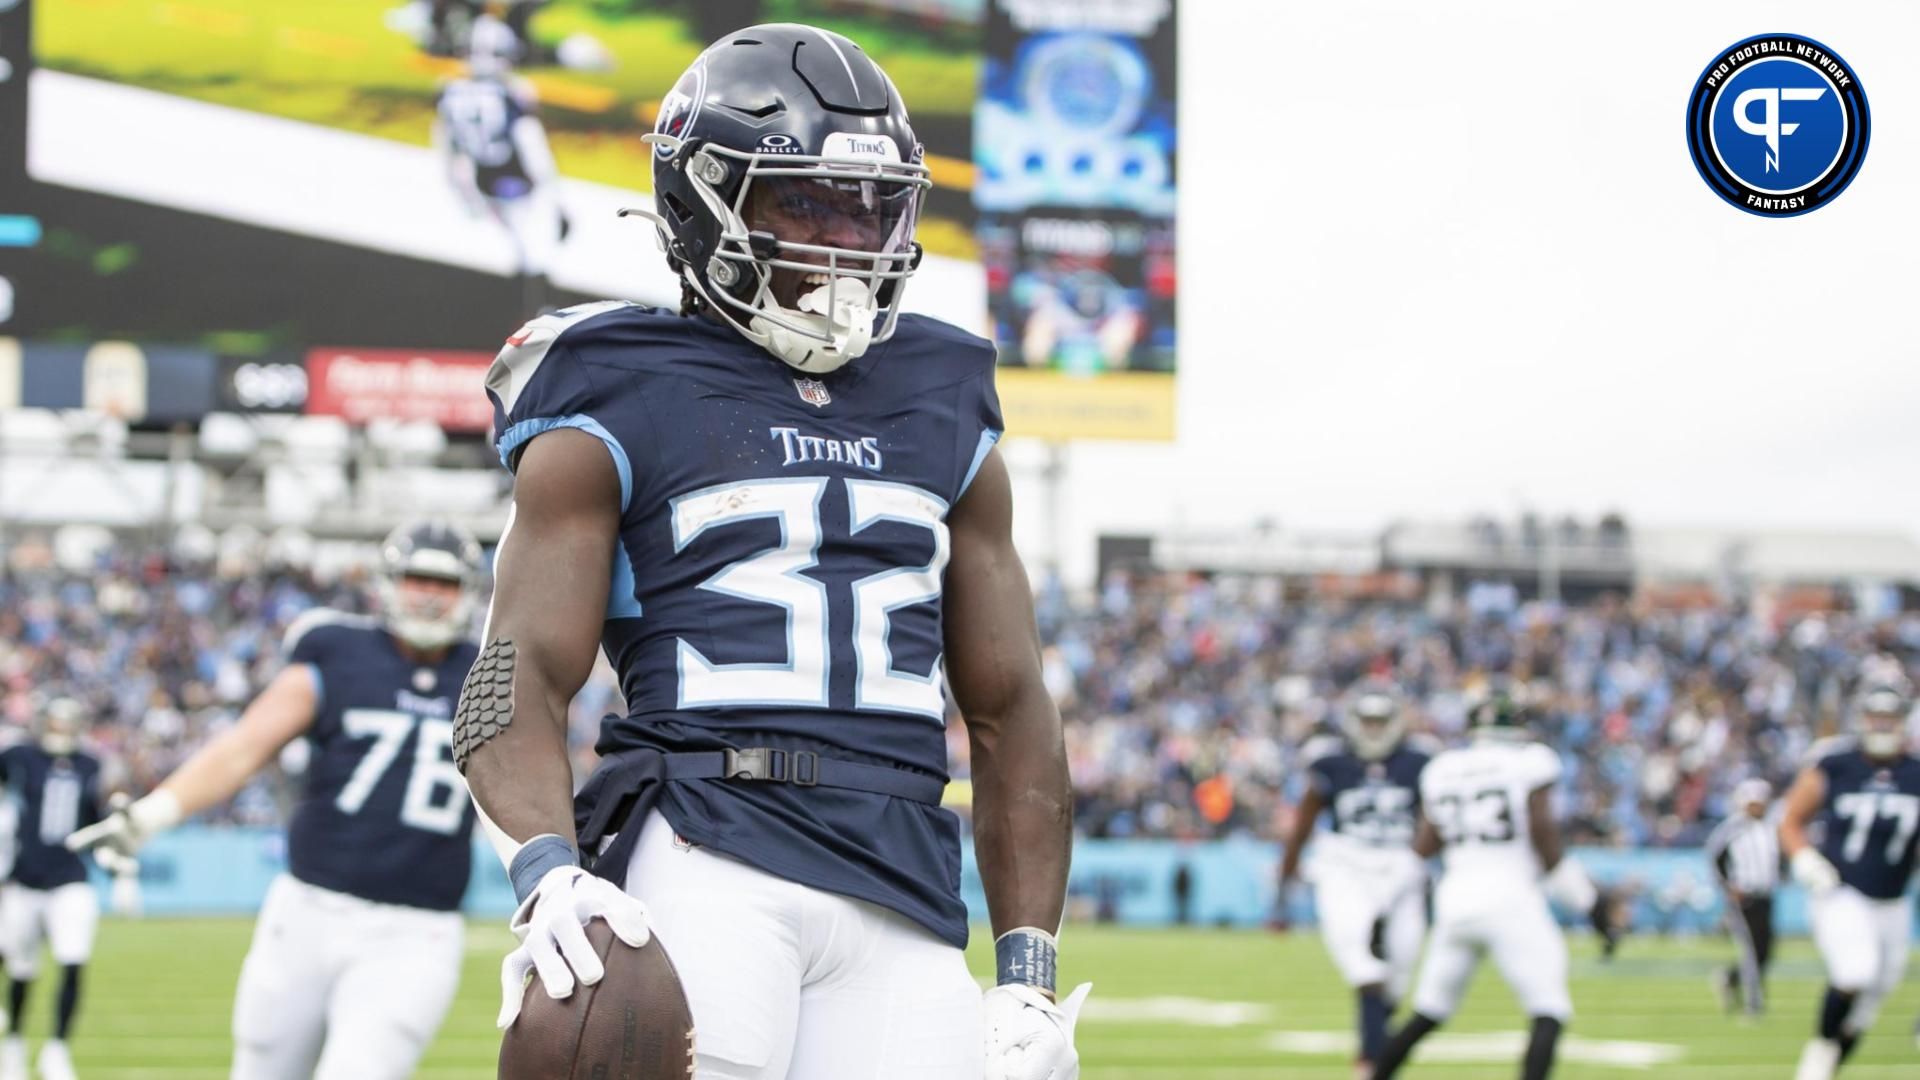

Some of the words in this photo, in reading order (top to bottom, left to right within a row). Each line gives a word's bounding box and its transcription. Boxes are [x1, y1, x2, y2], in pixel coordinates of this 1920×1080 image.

[755, 146, 801, 155] OAKLEY
[847, 138, 886, 155] TITANS
[769, 426, 883, 472] TITANS
[667, 475, 951, 725] 32
[335, 707, 470, 835] 76
[1833, 792, 1920, 866] 77
